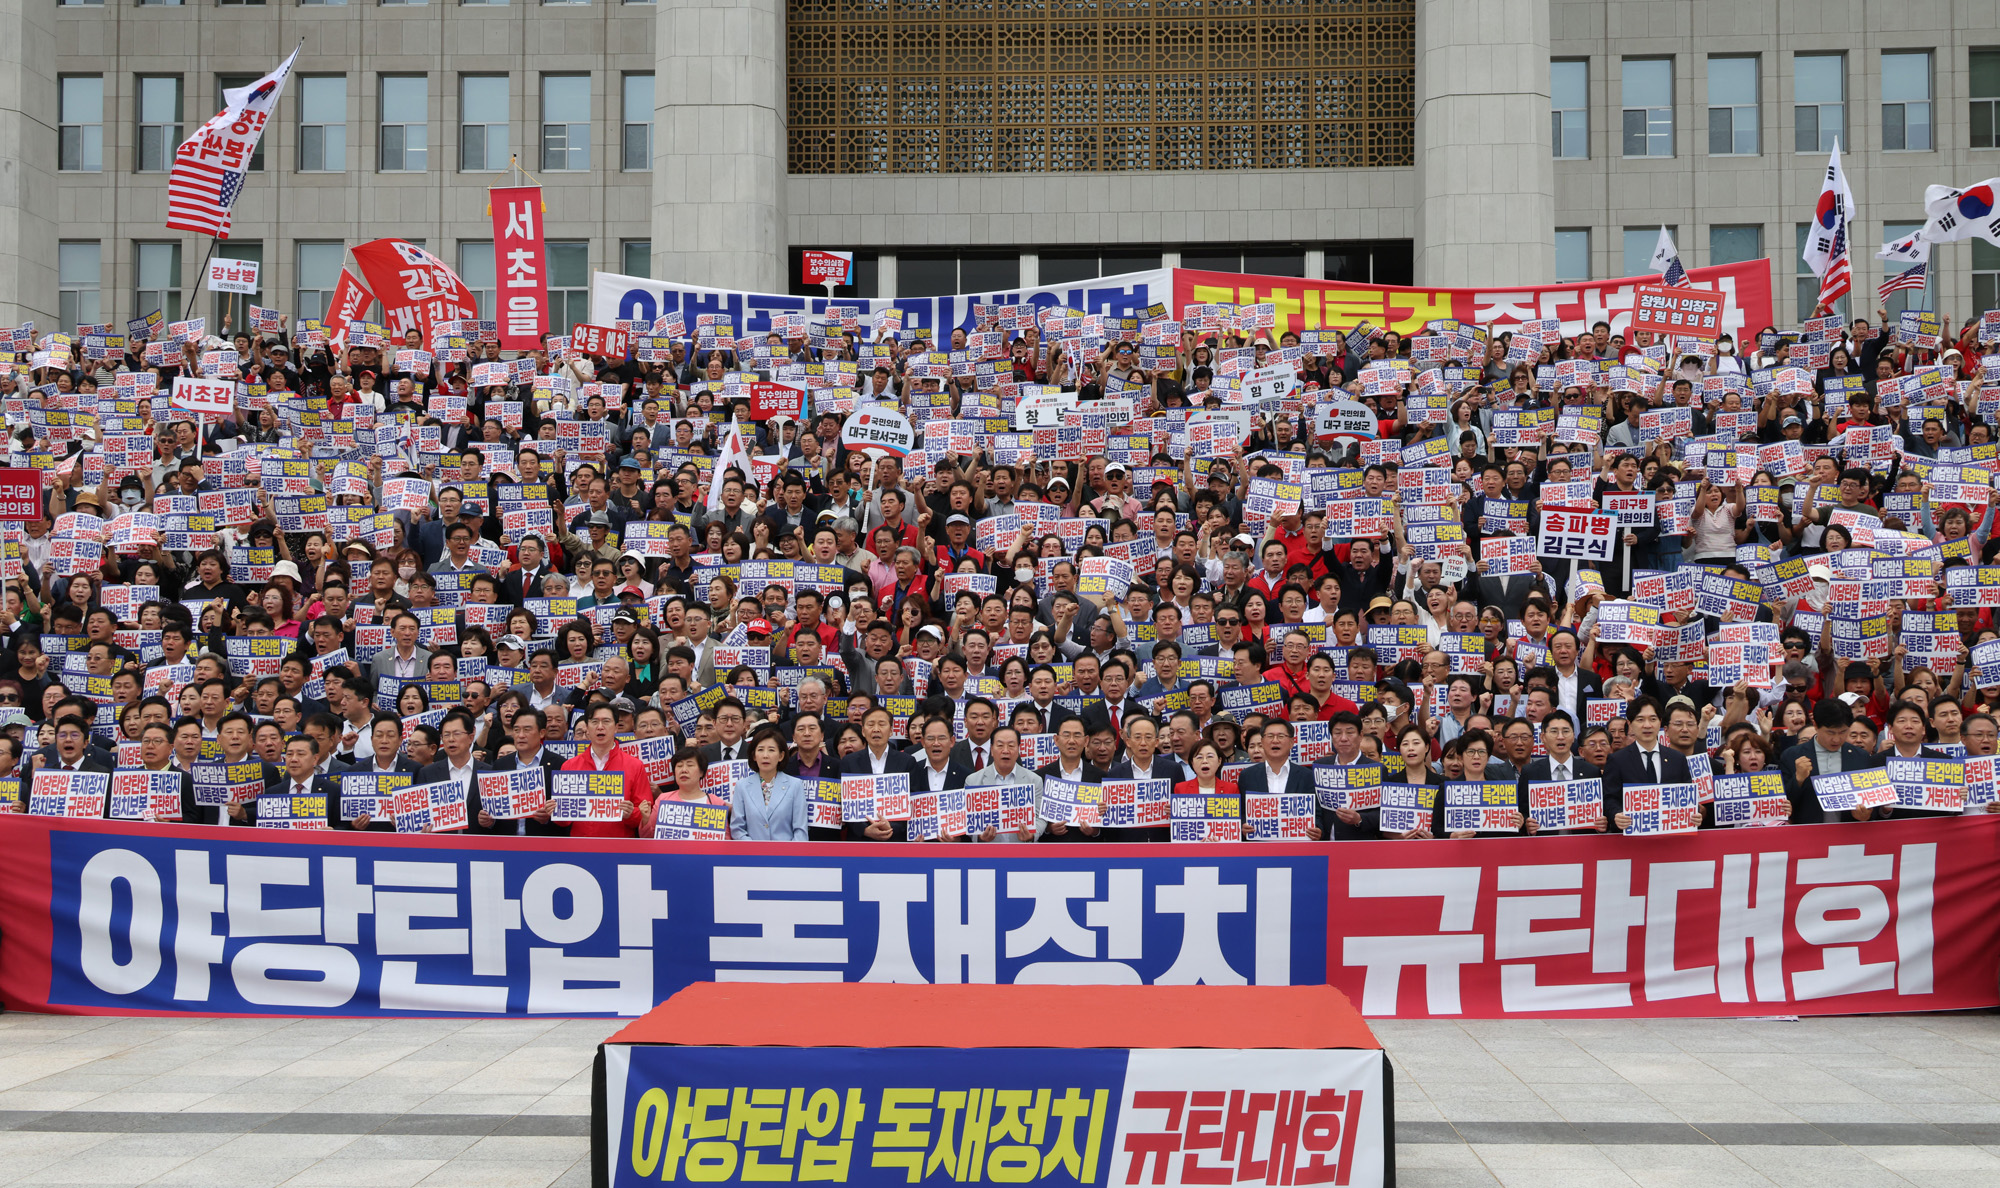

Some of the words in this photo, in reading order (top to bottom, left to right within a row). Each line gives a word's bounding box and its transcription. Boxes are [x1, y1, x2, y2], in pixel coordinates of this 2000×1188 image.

[212, 267, 255, 283] 강남병
[504, 200, 539, 336] 서초을
[810, 267, 844, 276] 상주문경
[1640, 294, 1676, 310] 창원시
[1680, 299, 1718, 314] 의창구
[175, 384, 231, 405] 서초갑
[759, 391, 797, 399] 보수의심장
[759, 400, 798, 409] 상주문경
[1407, 396, 1426, 408] 야당말살
[1427, 395, 1447, 408] 특검악법
[871, 417, 901, 428] 국민의힘
[1324, 421, 1341, 430] 대구
[1344, 420, 1370, 431] 달성군
[1409, 410, 1427, 422] 대통령은
[1428, 410, 1447, 422] 거부하라
[557, 423, 579, 438] 야당탄압
[580, 421, 604, 436] 독재정치
[849, 427, 868, 439] 대구
[870, 430, 908, 445] 달서구병
[1033, 428, 1056, 444] 야당탄압
[1058, 426, 1082, 442] 독재정치
[103, 437, 126, 453] 야당탄압
[127, 436, 153, 453] 독재정치
[557, 438, 578, 451] 정치보복
[581, 436, 604, 451] 규탄한다
[1034, 444, 1056, 458] 정치보복
[1058, 442, 1082, 458] 규탄한다
[128, 452, 152, 467] 규탄한다
[1610, 499, 1648, 510] 송파구병
[1546, 513, 1610, 536] 송파병
[1544, 536, 1607, 558] 김근식
[749, 619, 765, 628] MAGA
[1710, 645, 1741, 665] 야당탄압
[1743, 643, 1768, 664] 독재정치
[1710, 667, 1741, 686] 정치보복
[1743, 666, 1769, 685] 규탄한다
[193, 764, 226, 783] 야당말살
[228, 759, 262, 783] 특검악법
[1314, 767, 1346, 788] 야당말살
[1348, 766, 1381, 785] 특검악법
[1814, 774, 1852, 795] 야당말살
[1852, 768, 1890, 789] 특검악법
[33, 775, 70, 795] 야당탄압
[71, 775, 106, 794] 독재정치
[113, 774, 149, 794] 야당탄압
[150, 774, 180, 793] 독재정치
[196, 786, 228, 805] 대통령은
[230, 779, 264, 802] 거부하라
[479, 775, 508, 796] 야당탄압
[510, 773, 544, 793] 독재정치
[553, 774, 587, 794] 야당말살
[589, 774, 623, 794] 특검악법
[843, 778, 874, 798] 야당탄압
[876, 775, 908, 796] 독재정치
[1103, 784, 1135, 804] 야당탄압
[1137, 780, 1169, 801] 독재정치
[1530, 787, 1565, 808] 야당탄압
[1567, 781, 1601, 802] 독재정치
[1716, 778, 1748, 799] 야당말살
[1750, 773, 1782, 795] 특검악법
[31, 796, 66, 816] 정치보복
[67, 796, 104, 818] 규탄한다
[112, 796, 147, 816] 정치보복
[150, 795, 181, 815] 규탄한다
[258, 797, 290, 818] 야당말살
[292, 797, 326, 816] 특검악법
[394, 790, 428, 814] 야당탄압
[430, 782, 464, 805] 독재정치
[512, 789, 545, 813] 규탄한다
[967, 791, 999, 812] 야당탄압
[1001, 786, 1034, 806] 독재정치
[1172, 797, 1205, 817] 야당말살
[1207, 796, 1239, 817] 특검악법
[1318, 790, 1346, 810] 대통령은
[1349, 788, 1380, 809] 거부하라
[1820, 793, 1856, 809] 대통령은
[1858, 787, 1896, 808] 거부하라
[396, 813, 431, 832] 정치보복
[432, 802, 466, 827] 규탄한다
[658, 804, 692, 825] 야당말살
[694, 806, 726, 829] 특검악법
[843, 800, 874, 821] 정치보복
[877, 797, 909, 820] 규탄한다
[967, 812, 999, 832] 정치보복
[1002, 807, 1035, 829] 규탄한다
[1718, 802, 1751, 822] 대통령은
[1173, 822, 1205, 841] 대통령은
[1208, 821, 1240, 842] 거부하라
[78, 846, 669, 1016] 야당탄압
[708, 865, 1293, 986] 독재정치
[1343, 842, 1937, 1015] 규탄대회
[631, 1086, 867, 1183] 야당탄압
[872, 1086, 1110, 1184] 독재정치
[1125, 1088, 1363, 1186] 규탄대회
